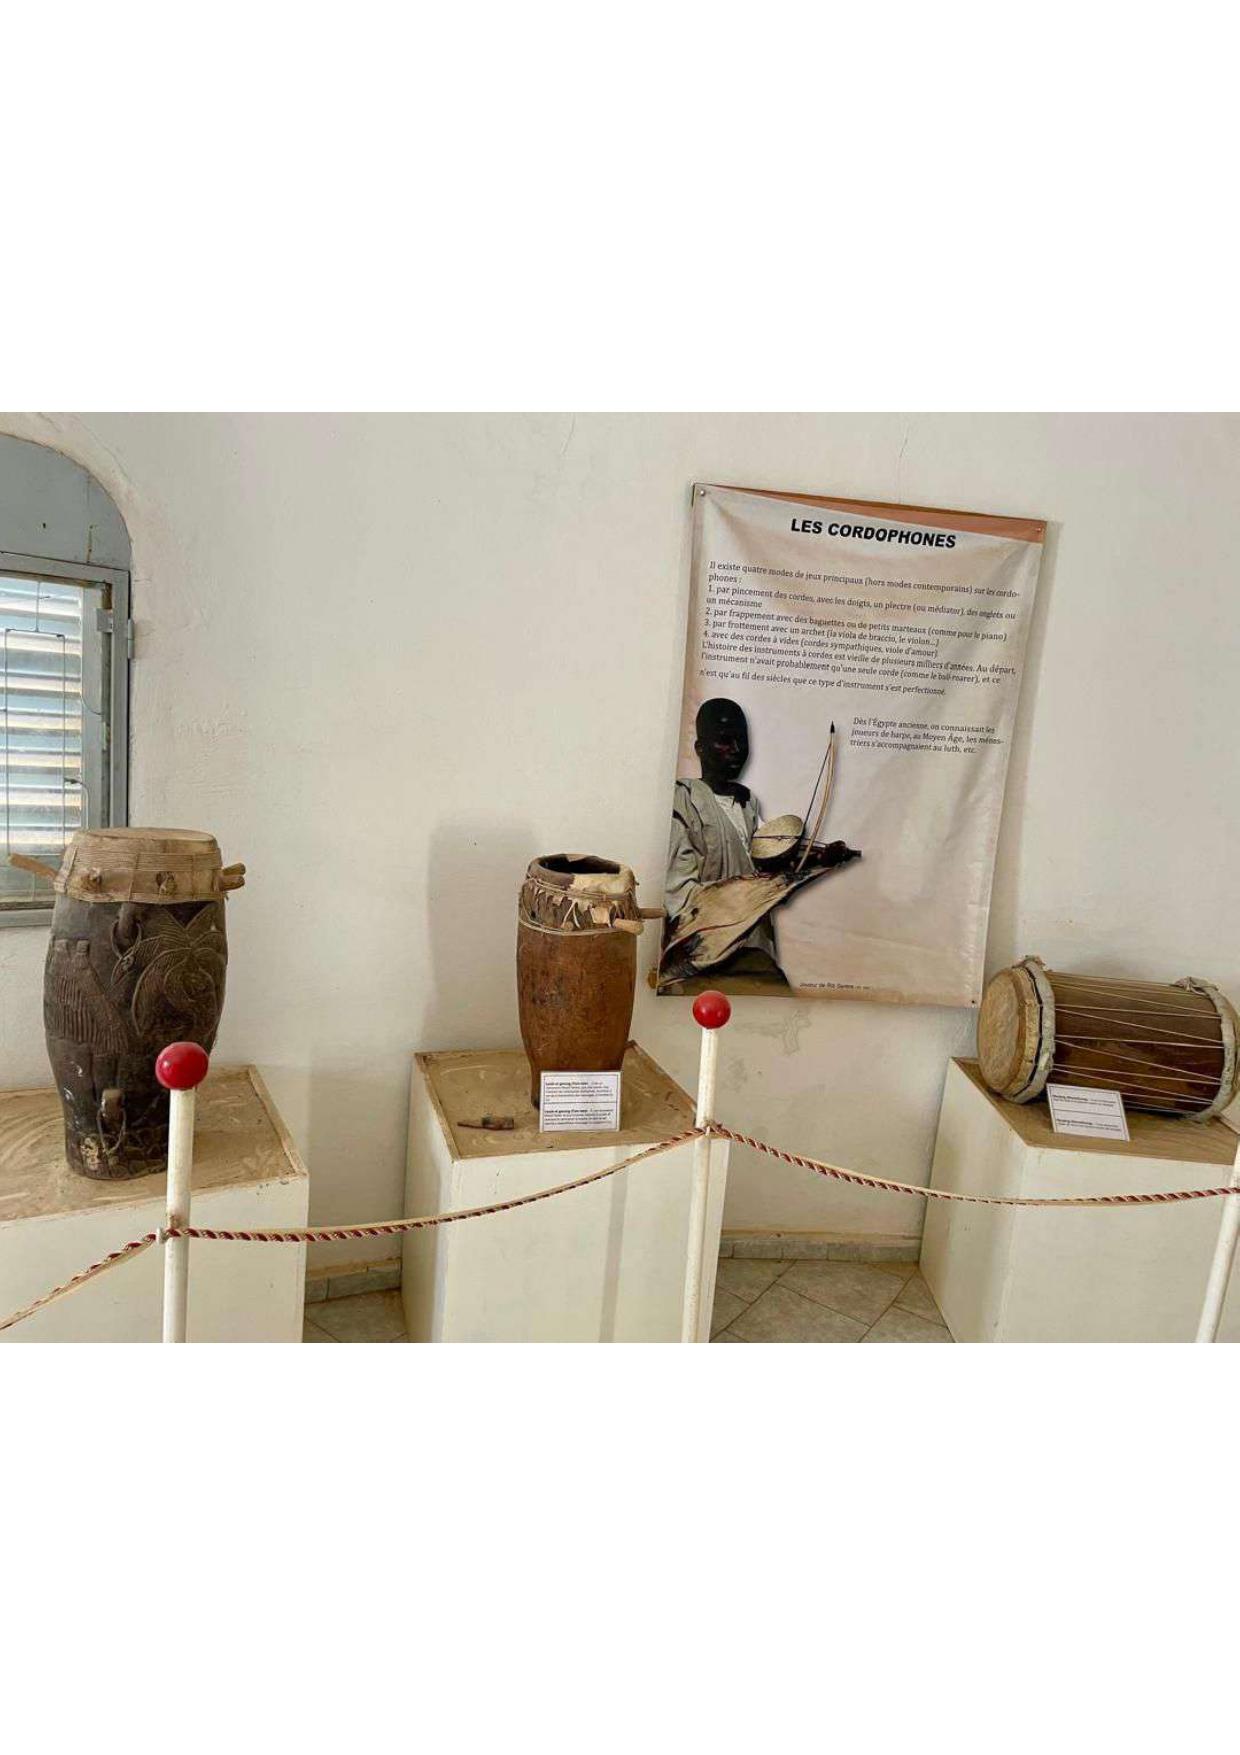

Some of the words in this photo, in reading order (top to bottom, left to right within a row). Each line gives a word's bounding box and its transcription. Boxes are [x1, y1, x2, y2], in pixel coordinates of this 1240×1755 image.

[791, 518, 822, 535] LES
[828, 523, 956, 549] CORDOPHONES
[709, 561, 716, 569] Il
[717, 563, 740, 571] existe
[742, 565, 767, 574] quatre
[769, 569, 794, 577] modes
[795, 570, 804, 578] de
[806, 573, 822, 581] jeux
[823, 574, 863, 585] principaux
[865, 577, 885, 586] (hors
[887, 581, 911, 589] modes
[913, 583, 973, 594] contemporains)
[709, 574, 737, 583] phones
[716, 586, 729, 594] par
[732, 588, 773, 597] pincement
[774, 591, 787, 599] des
[835, 596, 845, 605] les
[885, 601, 912, 610] plectre
[913, 604, 926, 612] (ou
[719, 598, 763, 607] mécanisme
[705, 607, 712, 615] 2.
[729, 609, 774, 621] frappement
[809, 617, 845, 627] baguettes
[869, 623, 890, 632] petits
[892, 625, 927, 634] marteaux
[928, 627, 956, 637] (comme
[957, 631, 973, 639] pour
[974, 630, 981, 638] le
[981, 632, 1007, 641] piano)
[713, 621, 725, 629] par
[728, 620, 770, 631] frottement
[801, 627, 825, 637] archet
[827, 629, 837, 639] (la
[839, 630, 857, 639] viola
[730, 632, 744, 640] des
[745, 634, 771, 643] cordes
[801, 639, 828, 648] (cordes
[702, 642, 737, 650] L'histoire
[739, 643, 753, 652] des
[754, 646, 800, 655] instruments
[808, 650, 833, 659] cordes
[847, 653, 869, 662] vieille
[882, 656, 915, 666] plusieurs
[916, 660, 943, 669] milliers
[976, 664, 988, 672] Au
[702, 652, 748, 663] l'instrument
[750, 656, 775, 665] n'avait
[776, 659, 830, 671] probablement
[831, 664, 857, 672] qu'une
[879, 668, 899, 676] corde
[900, 669, 929, 679] (comme
[930, 671, 937, 679] le
[718, 671, 740, 679] qu'au
[741, 671, 750, 679] fil
[751, 672, 765, 681] des
[766, 673, 791, 683] siècles
[792, 677, 807, 685] que
[819, 679, 834, 687] type
[836, 679, 884, 690] d'instrument
[853, 717, 867, 725] Dès
[985, 726, 995, 734] les
[850, 739, 870, 747] triers
[852, 729, 879, 737] joueurs
[923, 733, 946, 742] Moyen
